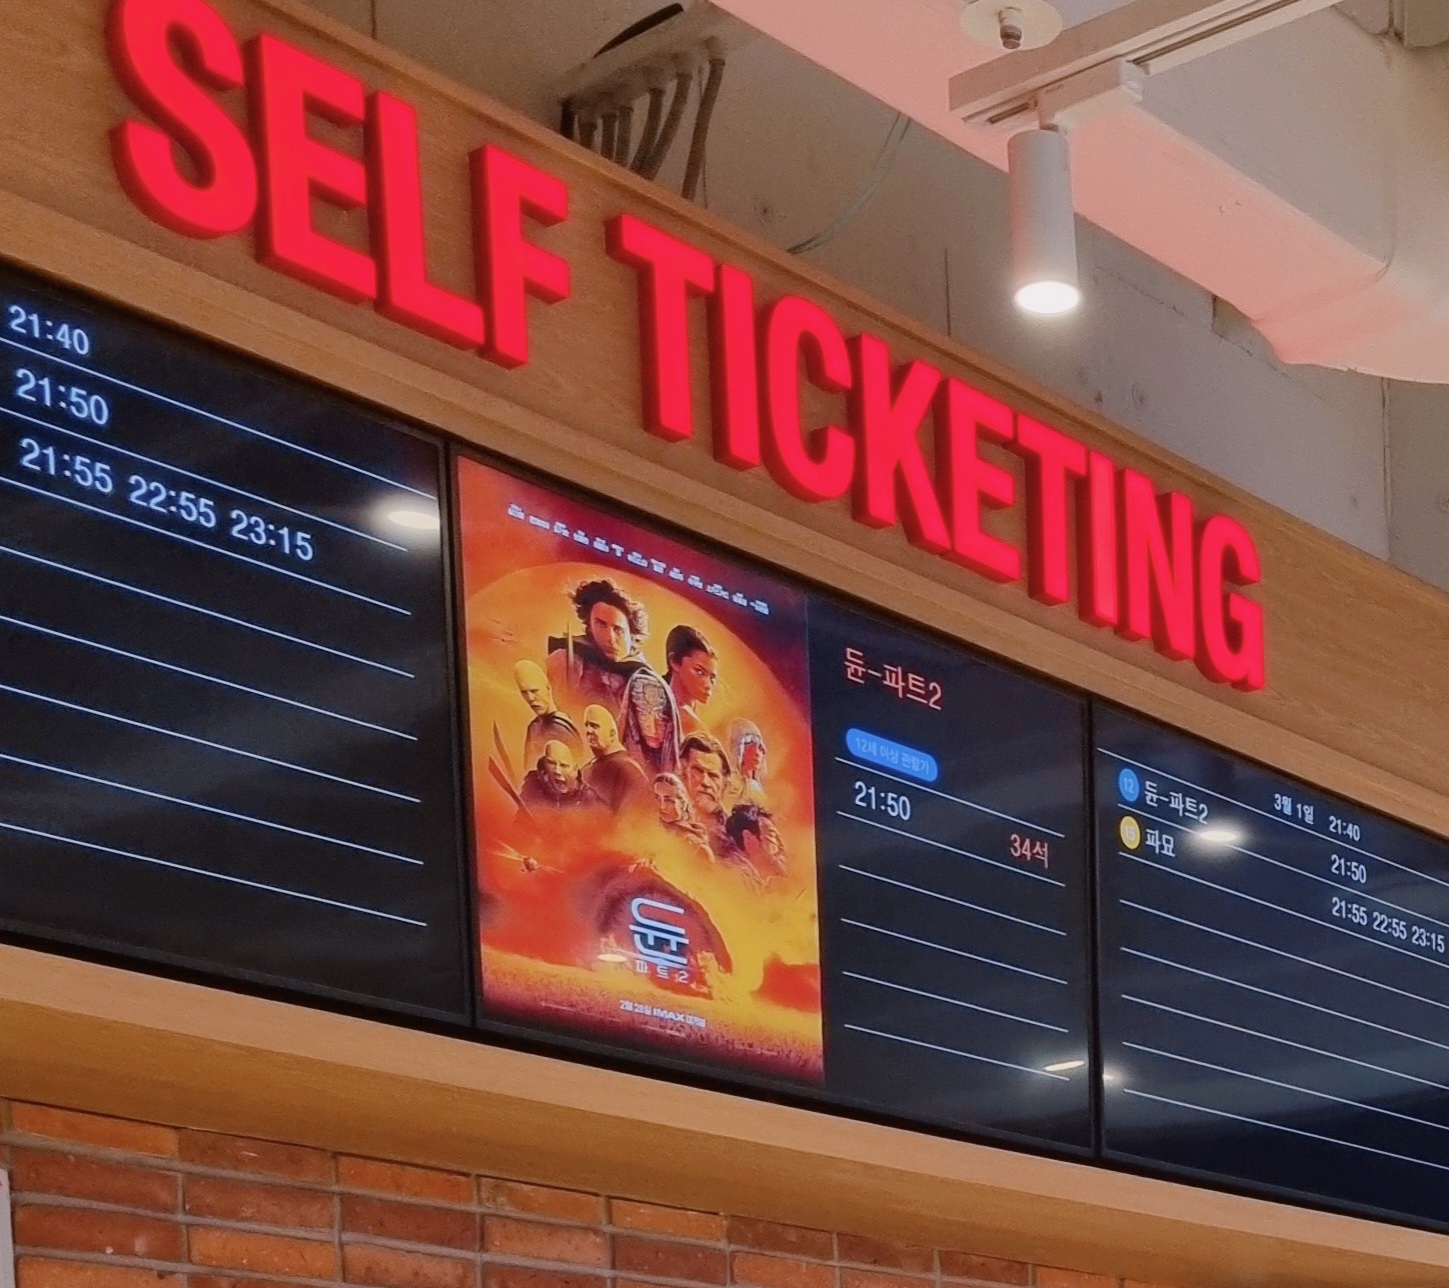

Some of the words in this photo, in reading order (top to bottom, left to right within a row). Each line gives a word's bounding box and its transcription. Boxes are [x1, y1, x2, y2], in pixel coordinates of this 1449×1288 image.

[8, 304, 91, 356] 21:40
[109, 0, 570, 370] SELF
[605, 212, 1266, 692] TICKETING
[15, 368, 109, 426] 21:50
[19, 437, 114, 494] 21:55
[128, 474, 217, 529] 22:55
[229, 509, 314, 561] 23:15
[844, 647, 942, 711] 듄-파트2
[854, 736, 878, 757] 12세
[880, 743, 901, 766] 이상
[854, 781, 911, 821] 21:50
[1144, 780, 1209, 825] 듄-파트2
[1296, 803, 1315, 825] 1일
[1328, 815, 1361, 841] 21:40
[1010, 833, 1049, 869] 34석
[1145, 828, 1176, 858] 파묘
[1330, 854, 1367, 884] 21:50
[1331, 897, 1368, 926] 21:55
[1372, 911, 1408, 940] 22:55
[1411, 925, 1446, 954] 23:15
